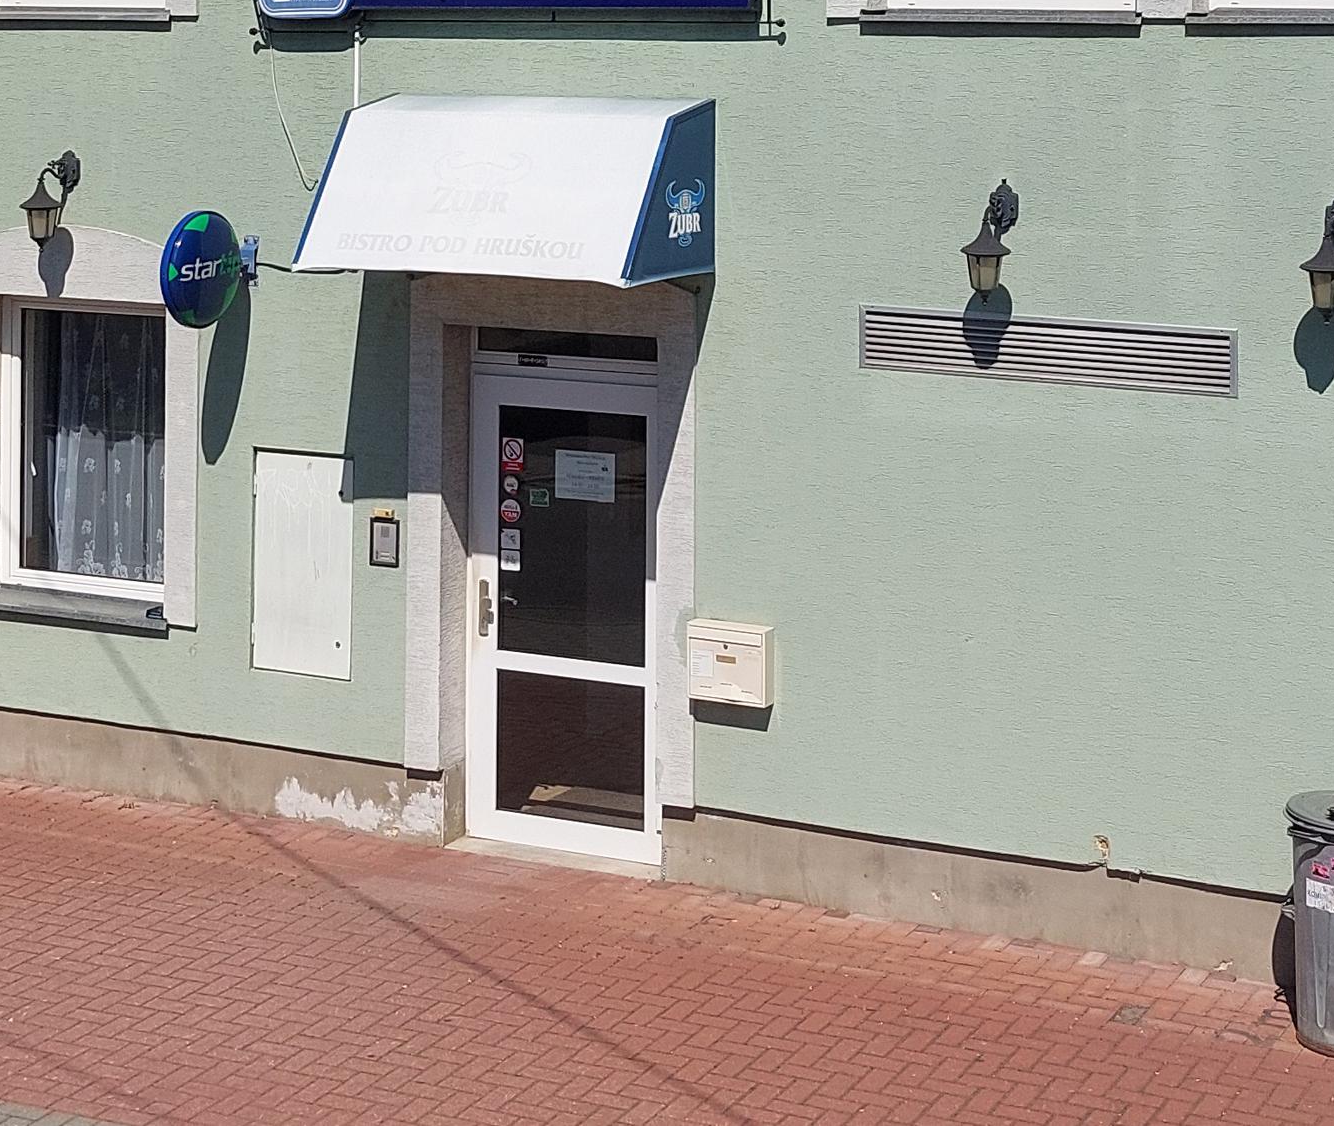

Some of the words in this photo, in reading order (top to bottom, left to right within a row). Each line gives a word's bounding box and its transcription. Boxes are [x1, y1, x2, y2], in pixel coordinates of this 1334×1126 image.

[668, 212, 702, 239] ZUBR
[336, 233, 413, 252] BISTRO
[419, 234, 467, 254] POD
[472, 233, 586, 260] HRUŠKOU
